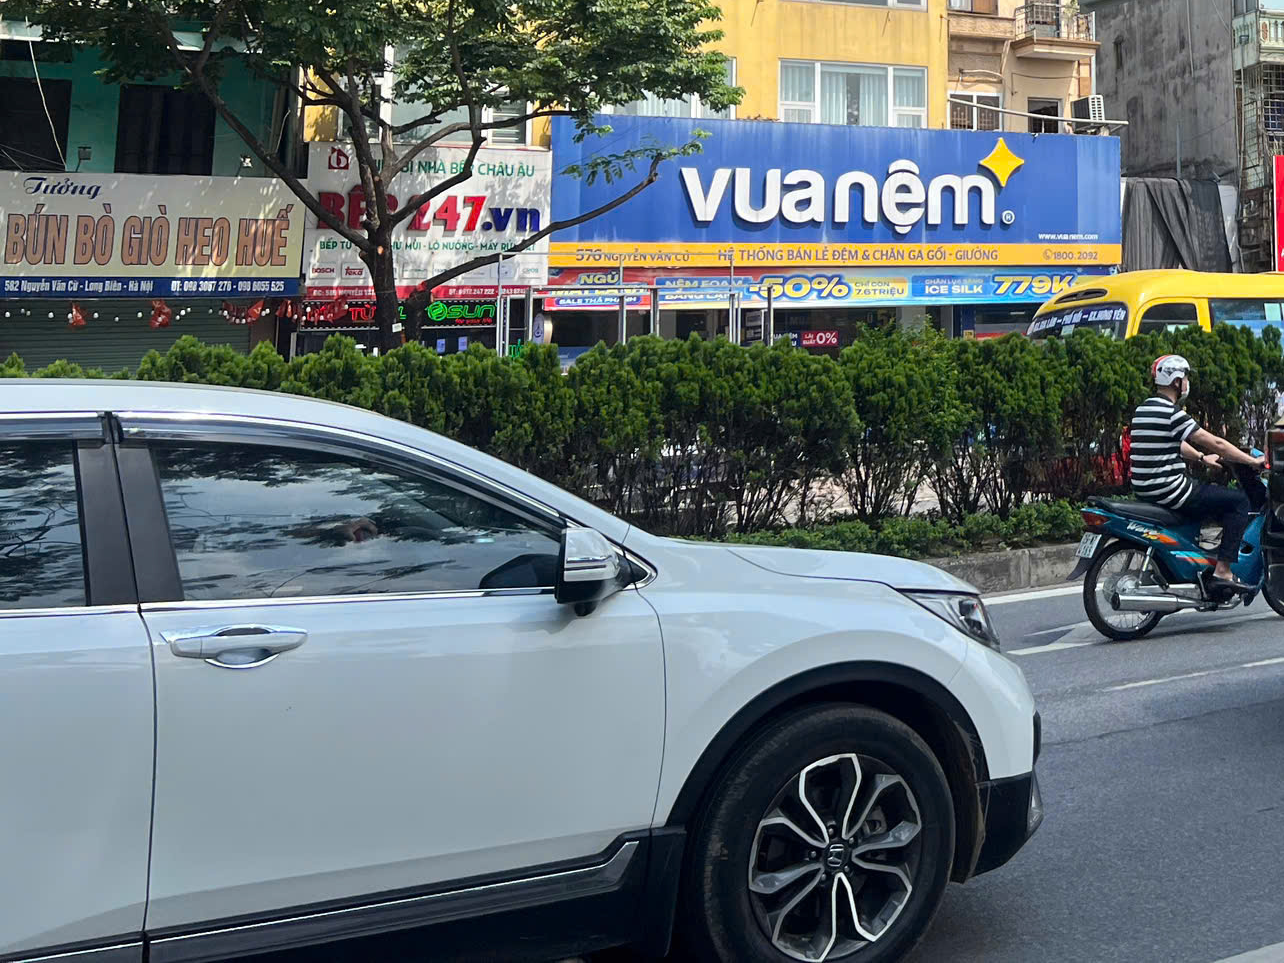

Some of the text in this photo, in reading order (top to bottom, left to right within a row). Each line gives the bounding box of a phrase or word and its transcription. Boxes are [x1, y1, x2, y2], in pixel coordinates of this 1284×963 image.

[418, 157, 446, 174] NHÀ
[478, 161, 514, 177] CHÂU
[517, 162, 535, 177] ÂU
[23, 175, 102, 200] Tưởng
[4, 203, 294, 267] BÚN BÒ GIÒ HEO HUẾ
[480, 239, 498, 252] MÁY
[603, 247, 649, 262] NGUYỄN
[739, 245, 784, 262] THỐNG
[787, 245, 813, 261] BÁN
[815, 245, 829, 261] LẺ
[832, 246, 859, 264] ĐỆM
[862, 249, 870, 261] &
[873, 246, 905, 261] CHĂN
[908, 249, 924, 262] GA
[926, 245, 946, 261] GỐI
[955, 245, 999, 262] GIƯỜNG
[85, 280, 103, 294] Long
[925, 285, 983, 294] ICE SILK
[993, 275, 1074, 295] 779K
[816, 332, 837, 345] 0%
